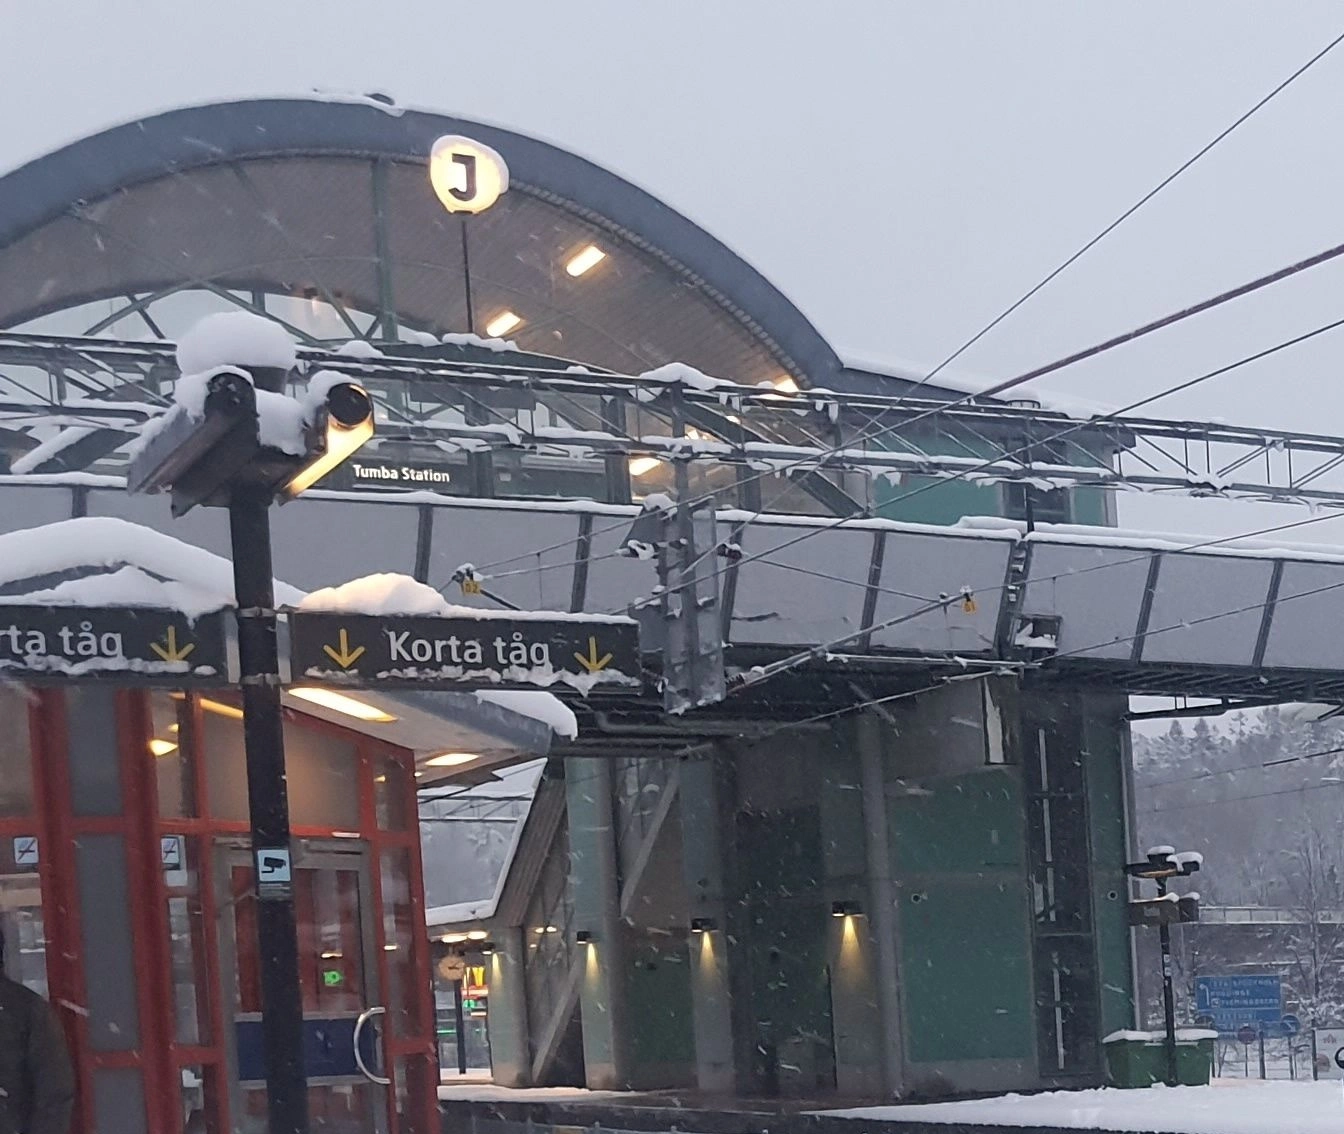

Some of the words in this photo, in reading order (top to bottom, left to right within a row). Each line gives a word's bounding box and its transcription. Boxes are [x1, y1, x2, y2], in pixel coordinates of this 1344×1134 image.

[448, 152, 477, 202] J
[352, 464, 399, 480] Tumba
[401, 467, 450, 482] Station
[388, 631, 482, 664] Korta
[493, 631, 553, 667] tåg
